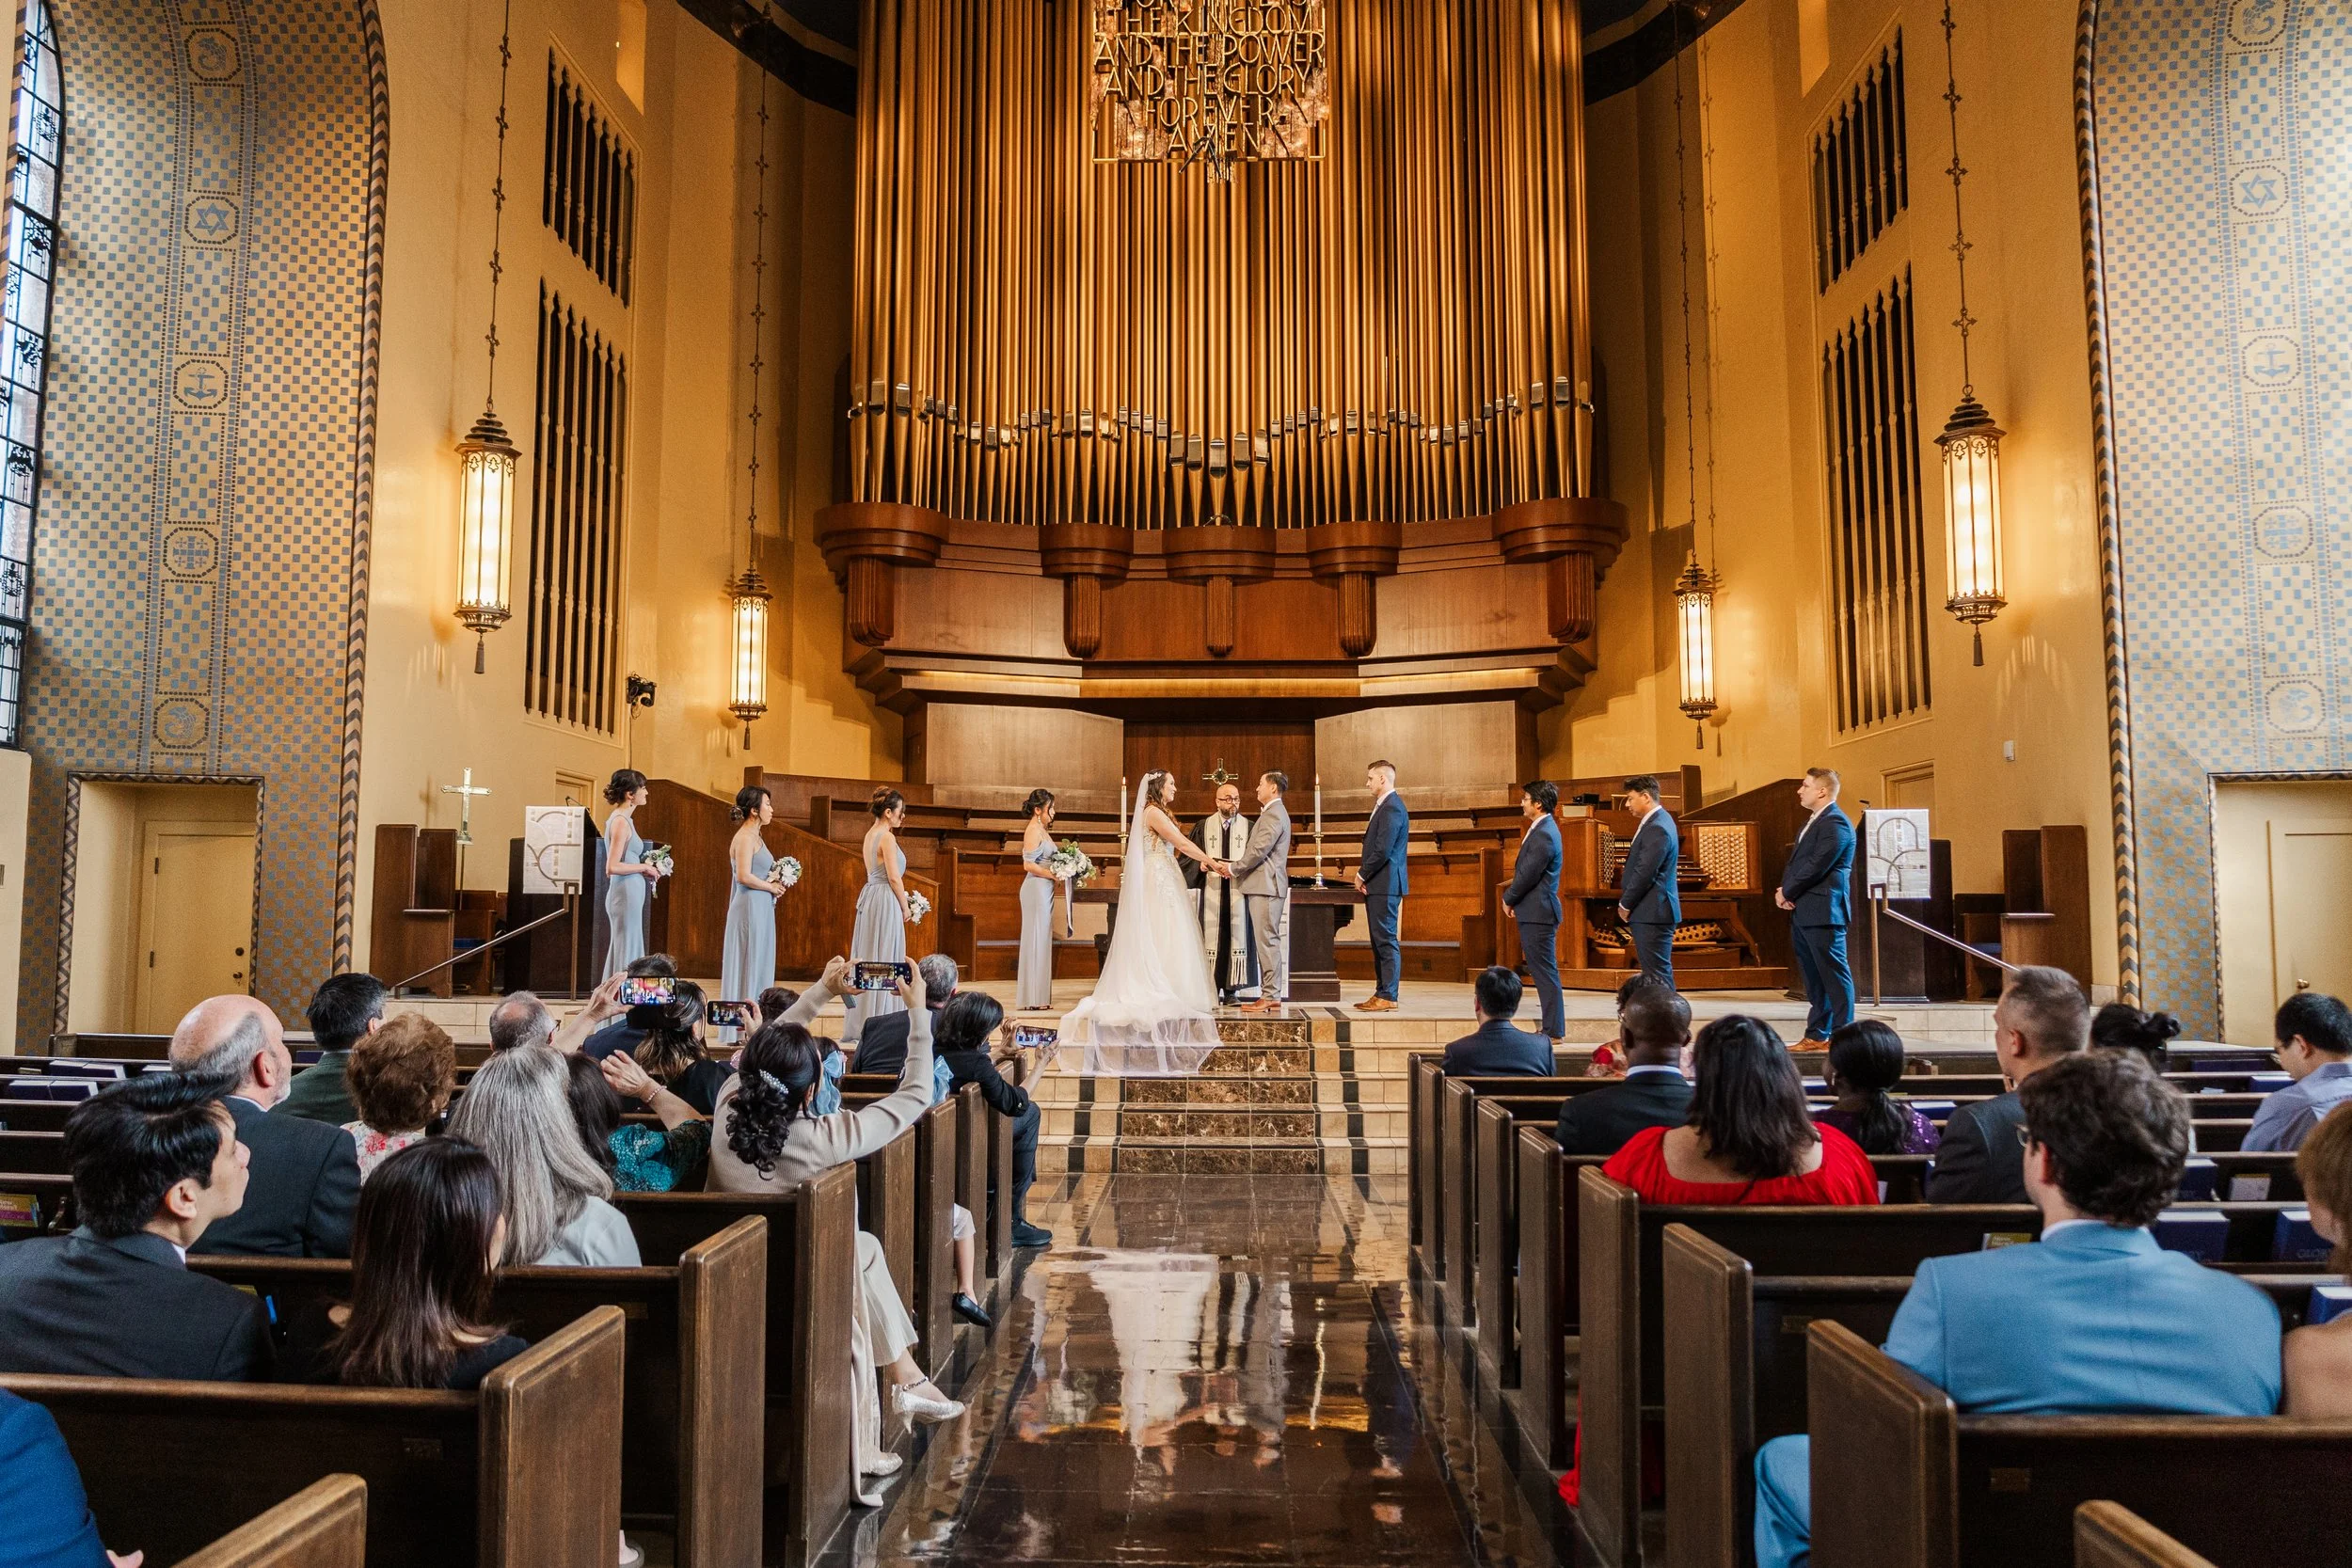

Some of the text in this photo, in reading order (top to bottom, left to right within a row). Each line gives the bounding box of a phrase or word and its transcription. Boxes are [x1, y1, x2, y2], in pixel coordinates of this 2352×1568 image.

[1105, 5, 1313, 37] THE KINGDOM
[1093, 32, 1325, 66] AND THE POWER
[1104, 62, 1311, 97] AND THE GLORY
[1145, 94, 1275, 127] FOREVER
[1168, 122, 1261, 152] AMEN
